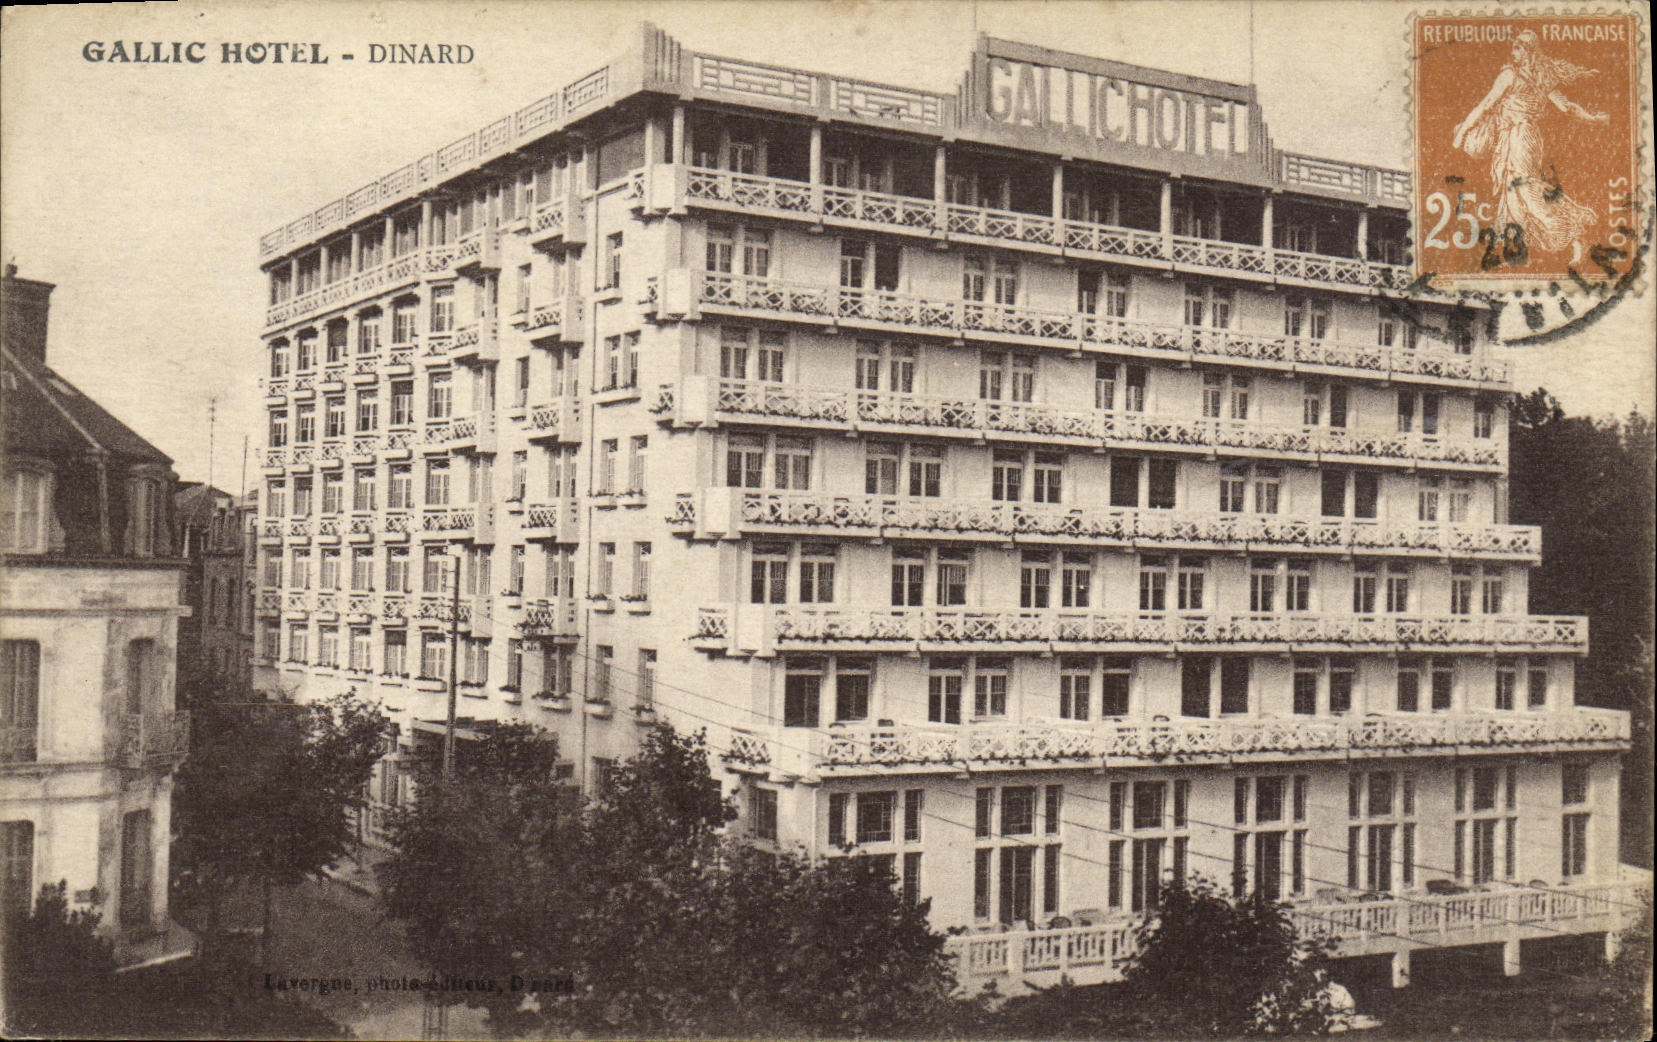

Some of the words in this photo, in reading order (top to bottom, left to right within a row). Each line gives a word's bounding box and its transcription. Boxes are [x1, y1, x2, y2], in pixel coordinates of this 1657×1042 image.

[1424, 25, 1513, 43] REPUBLIQUE
[1542, 24, 1625, 44] FRANÇAISE
[1607, 175, 1629, 263] POSTES
